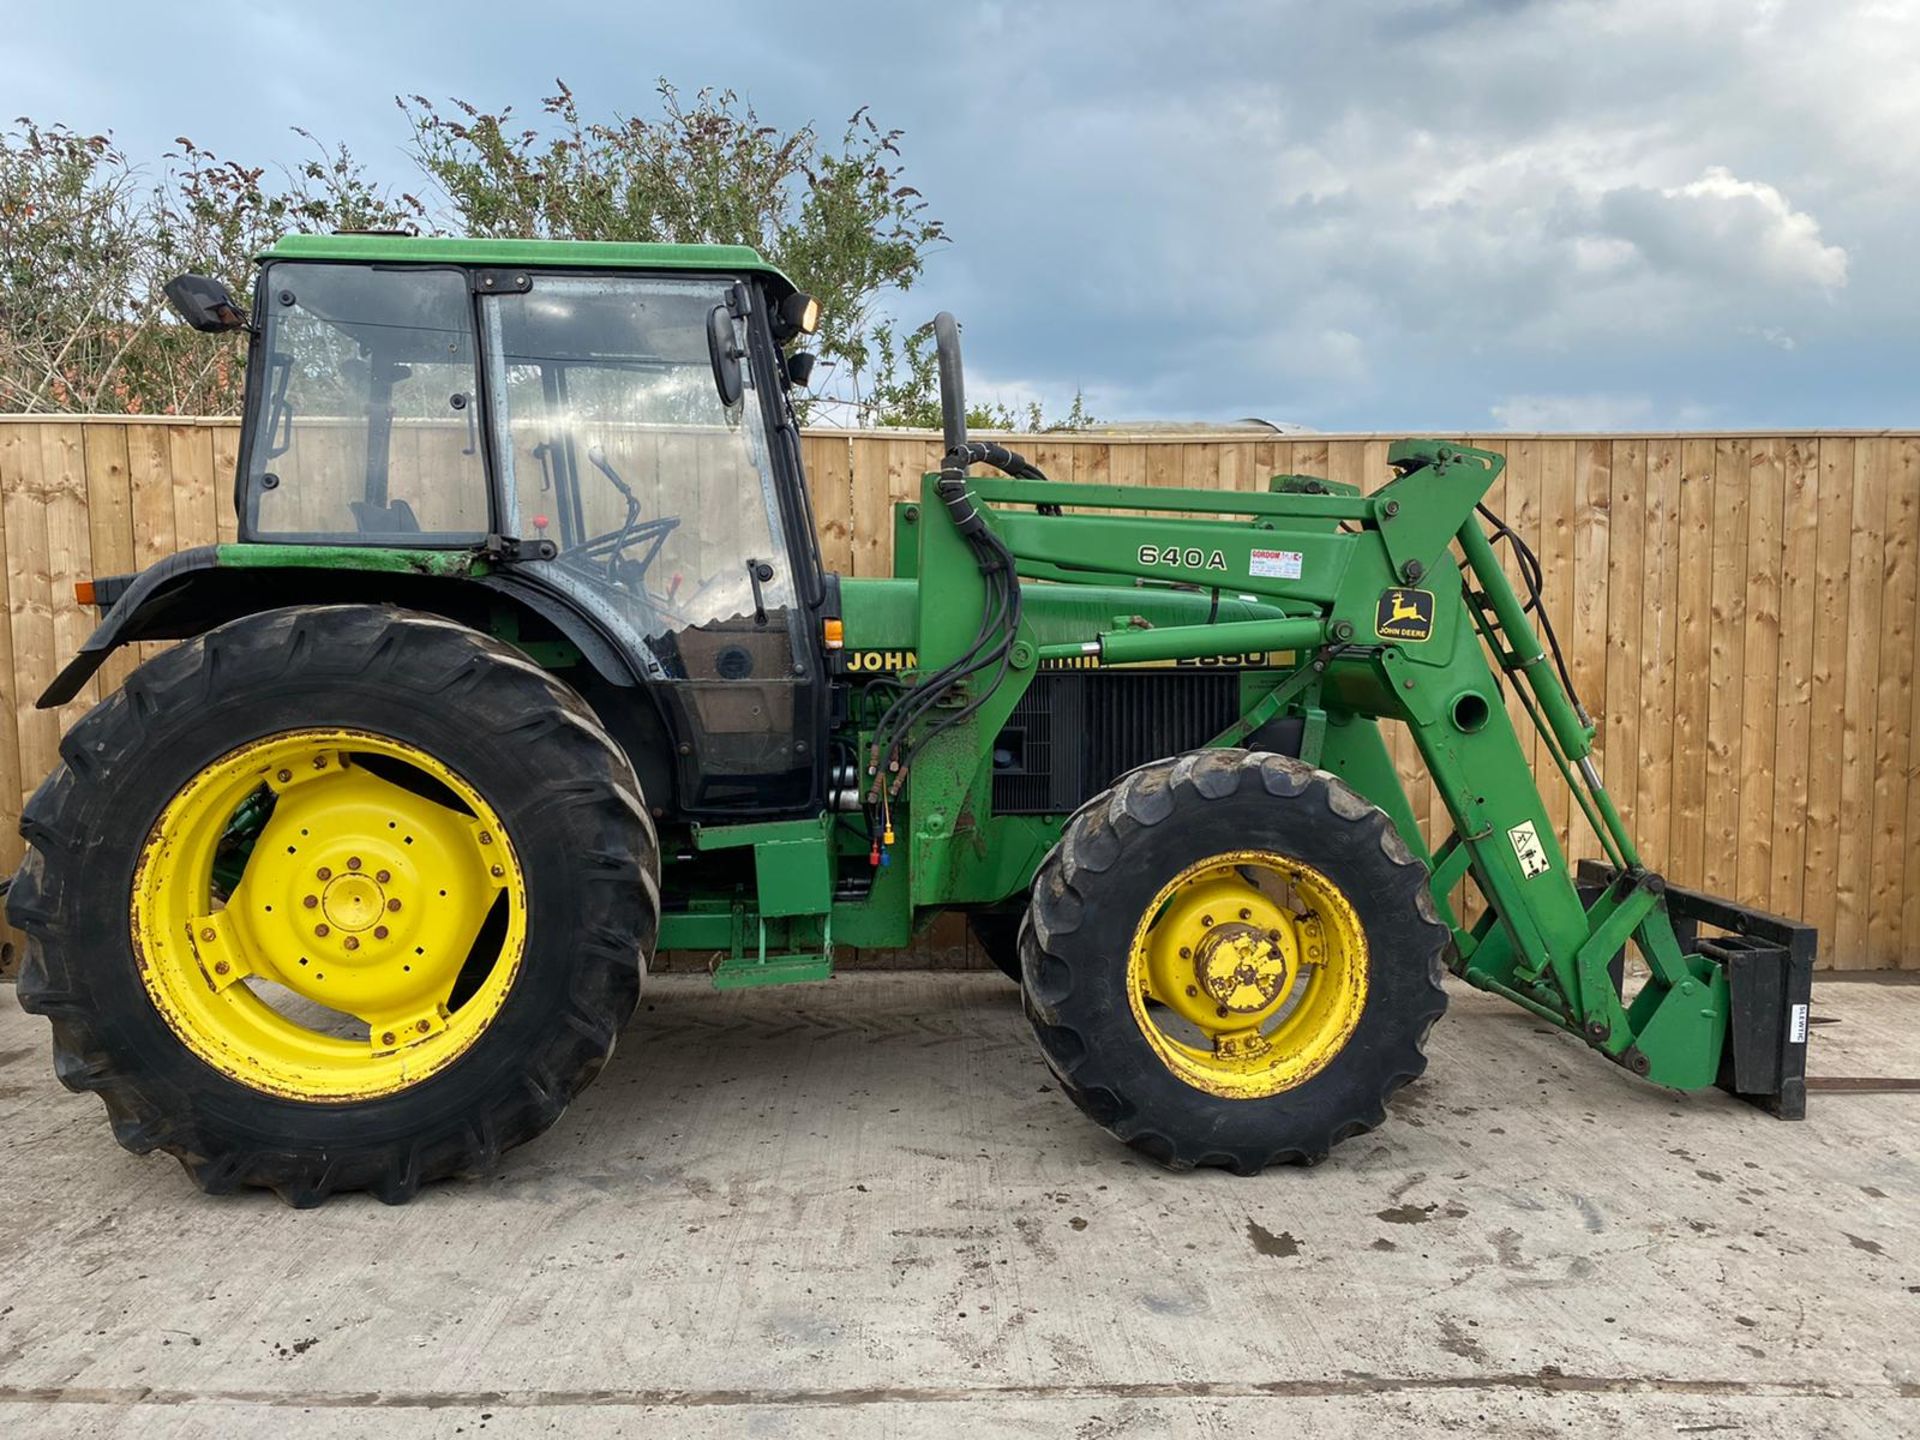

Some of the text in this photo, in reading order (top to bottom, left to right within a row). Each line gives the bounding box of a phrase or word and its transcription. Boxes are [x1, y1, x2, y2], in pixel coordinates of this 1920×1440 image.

[1138, 545, 1227, 571] 640A
[1379, 627, 1426, 637] JOHN DEERE
